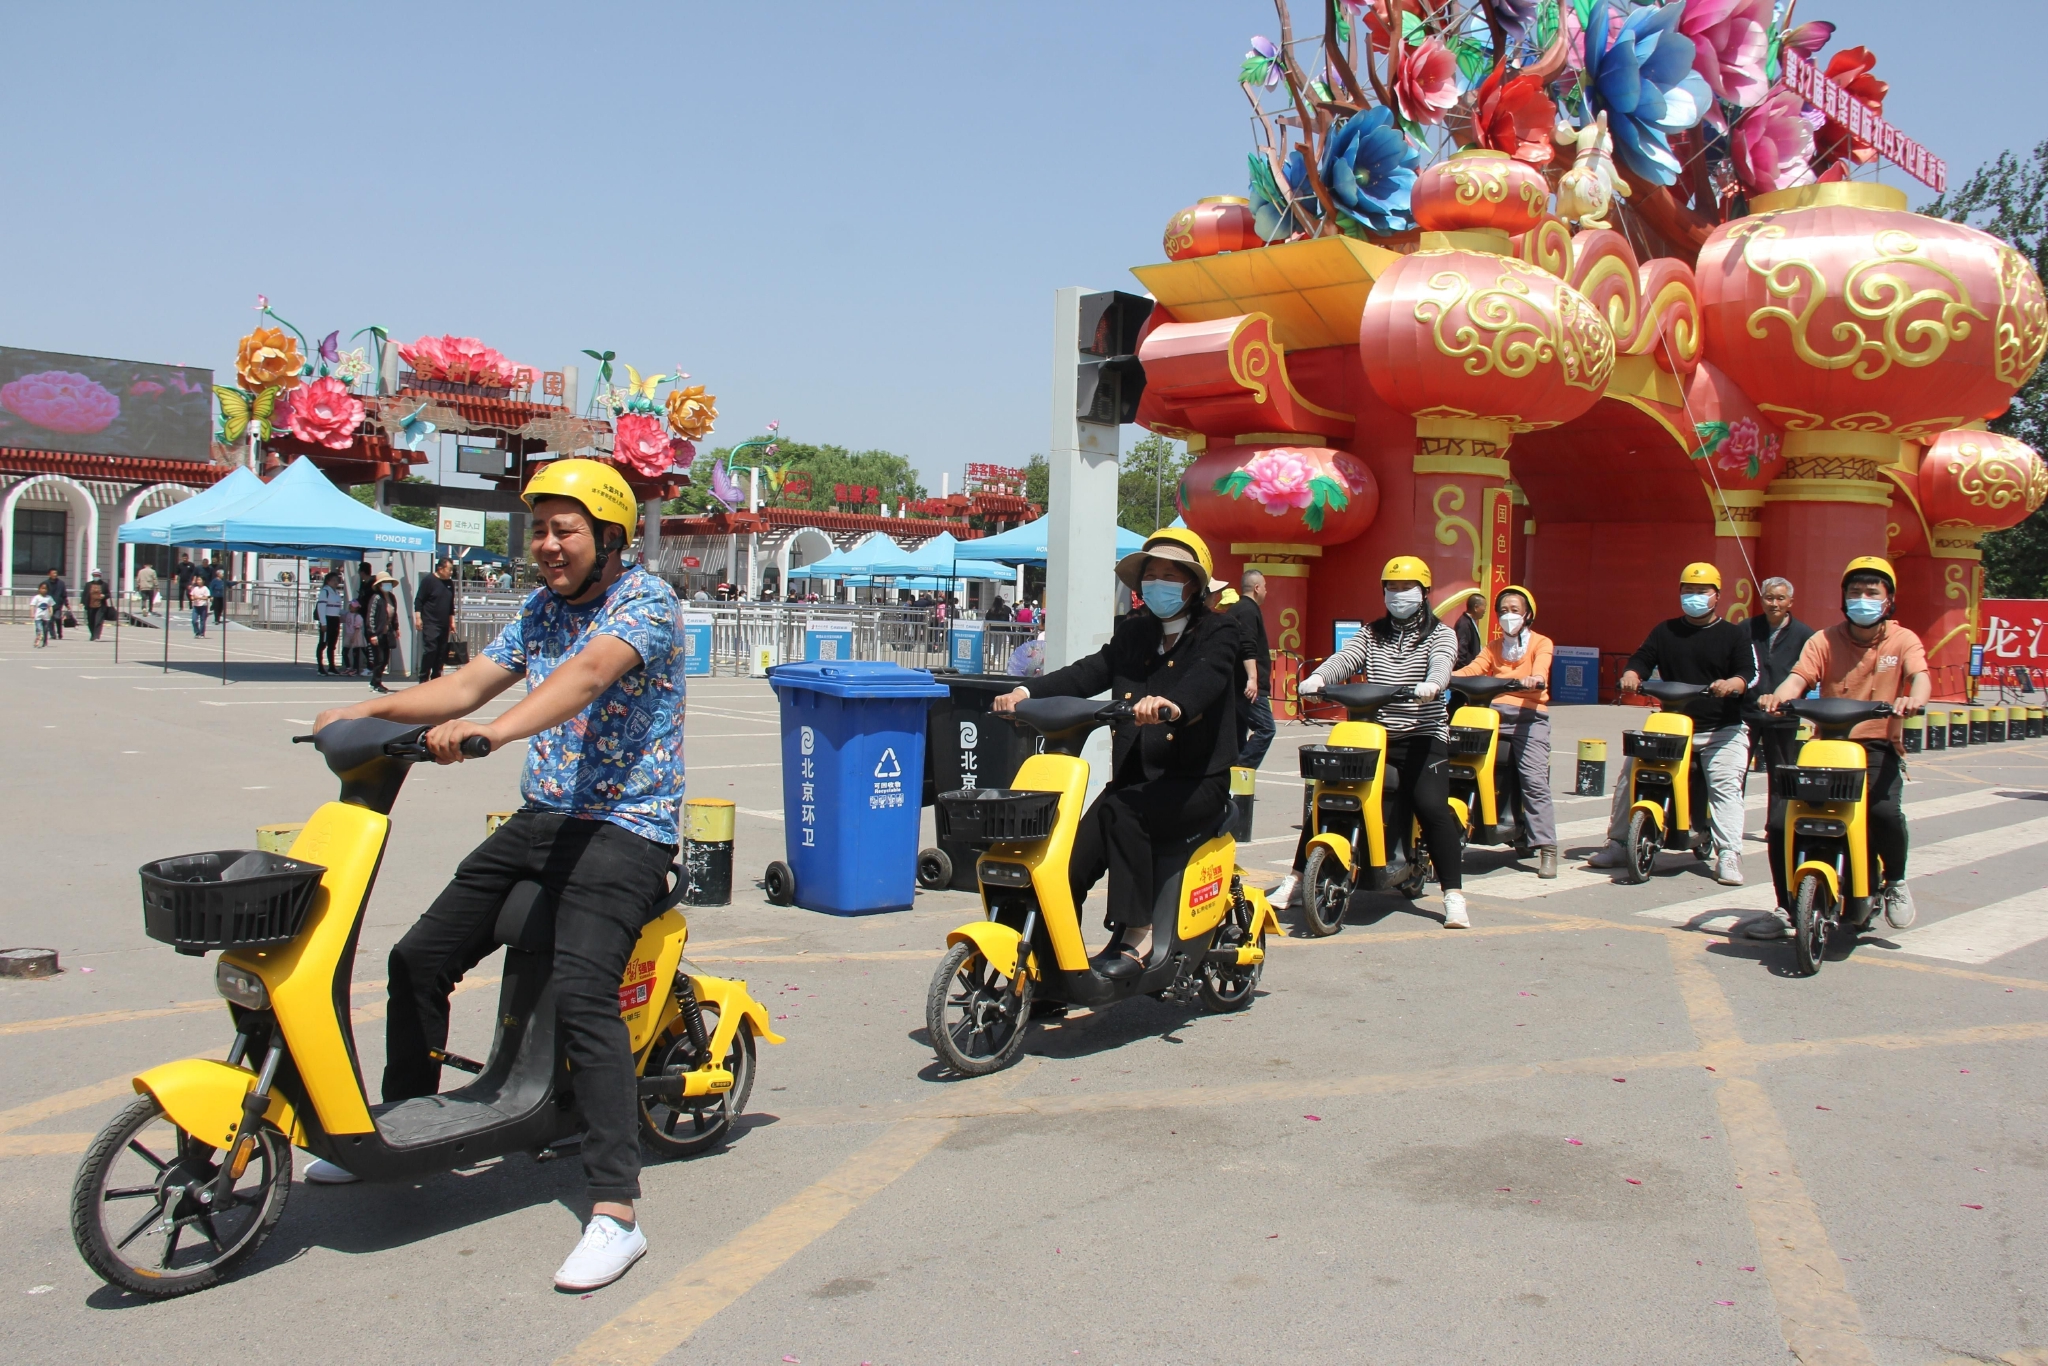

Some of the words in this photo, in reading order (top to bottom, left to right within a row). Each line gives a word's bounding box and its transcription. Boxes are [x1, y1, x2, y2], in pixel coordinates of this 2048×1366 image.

[1785, 48, 1947, 192] 第32届菏泽国际牡丹文化旅游节
[834, 483, 880, 505] 售票处
[375, 533, 406, 543] HONOR
[874, 781, 901, 789] 可回收物
[801, 757, 815, 847] 北京环卫
